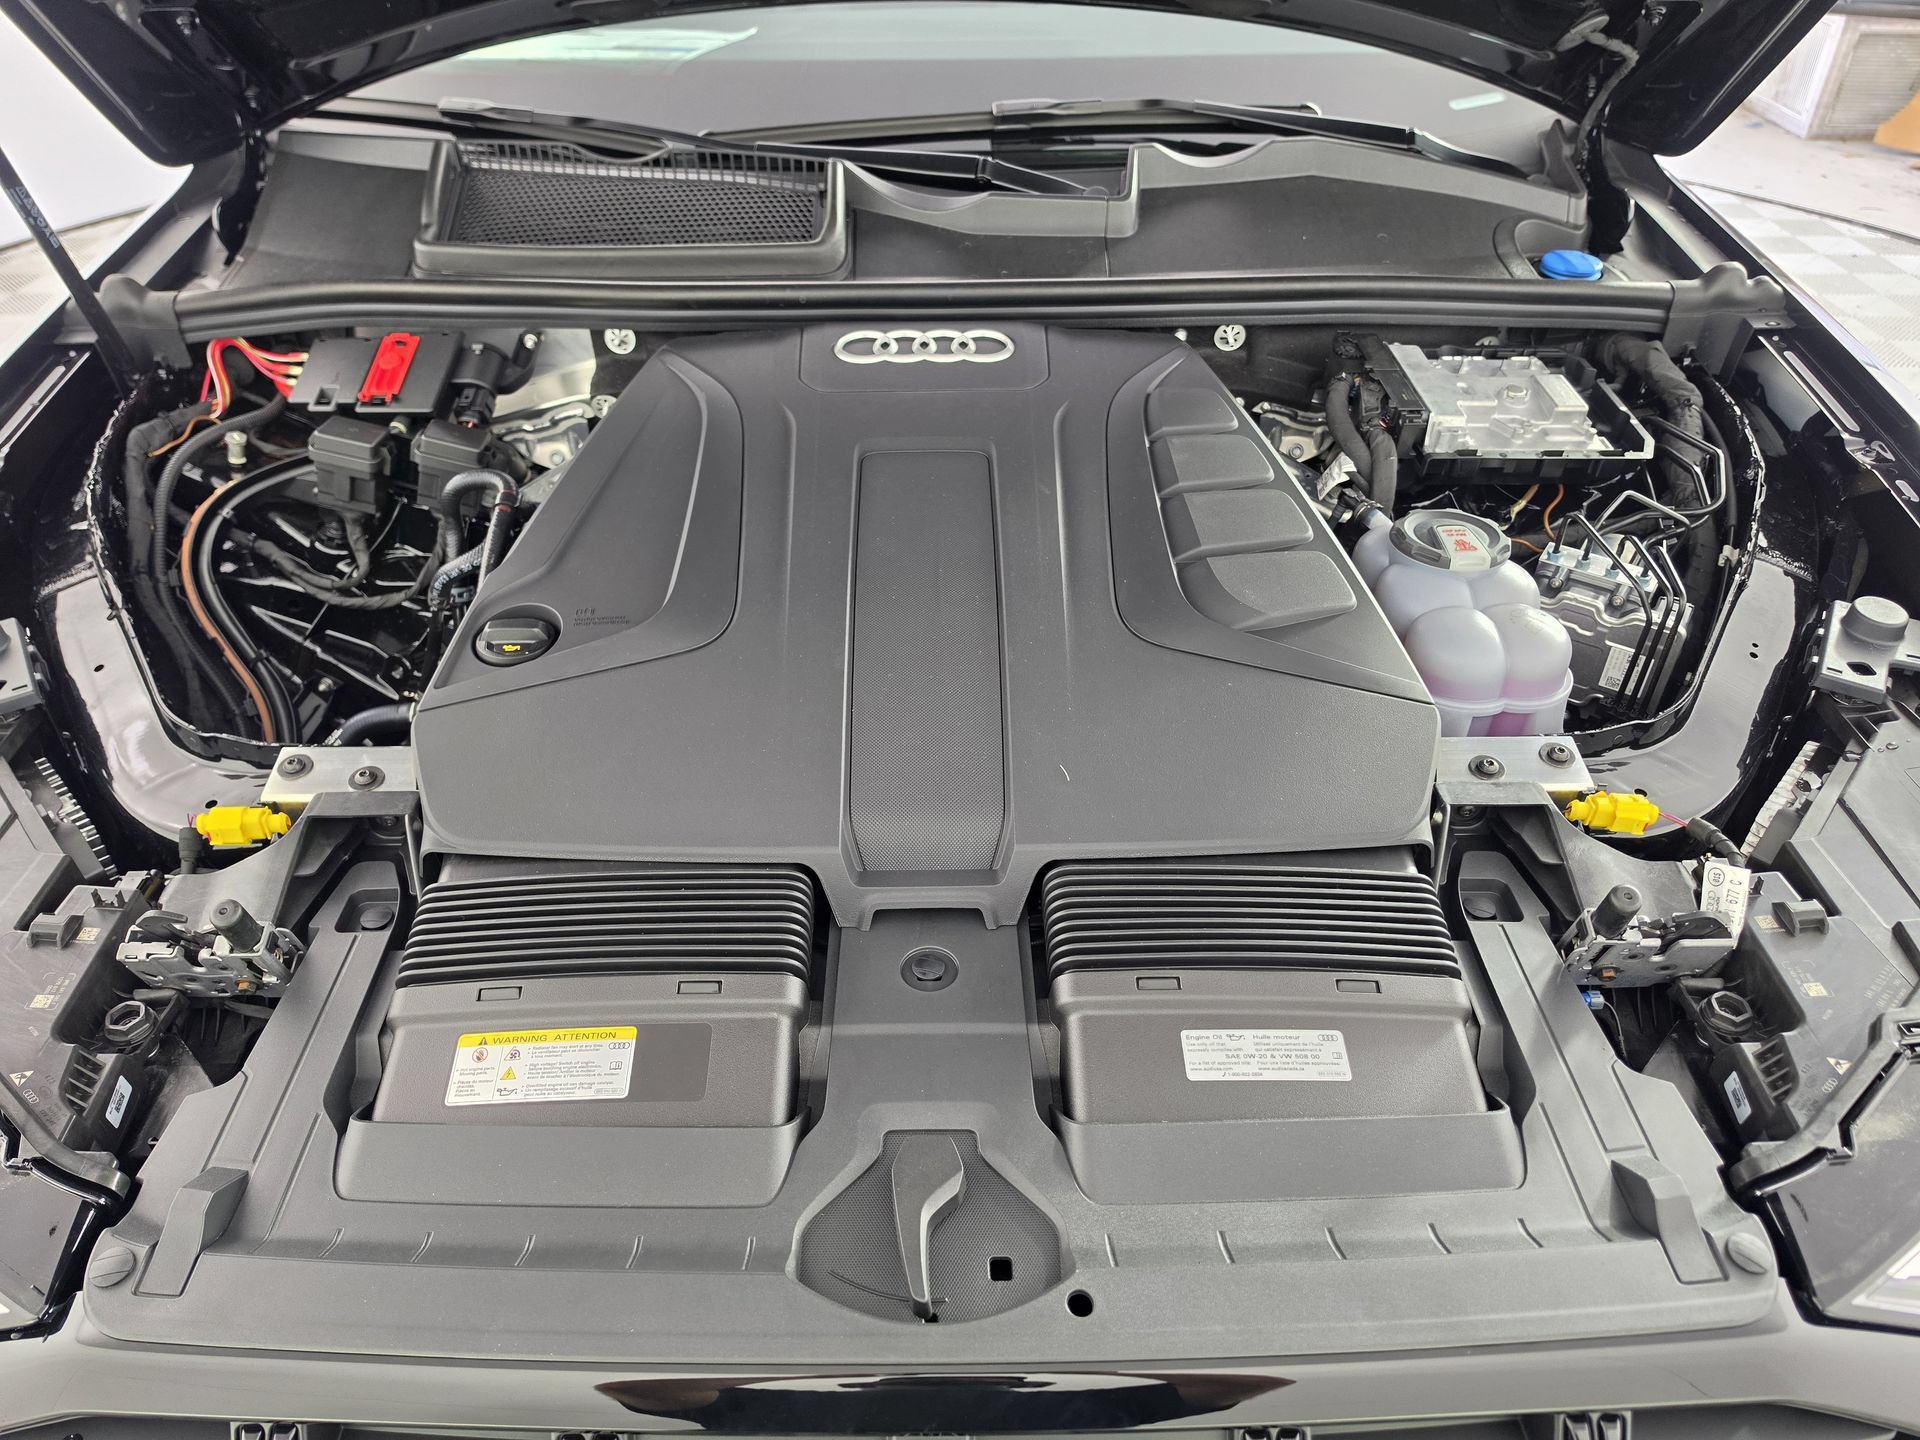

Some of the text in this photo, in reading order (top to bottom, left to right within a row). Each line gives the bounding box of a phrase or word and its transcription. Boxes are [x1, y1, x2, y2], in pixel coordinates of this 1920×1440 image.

[1726, 888, 1740, 904] 677
[492, 1032, 617, 1044] WARNING ATTENTION
